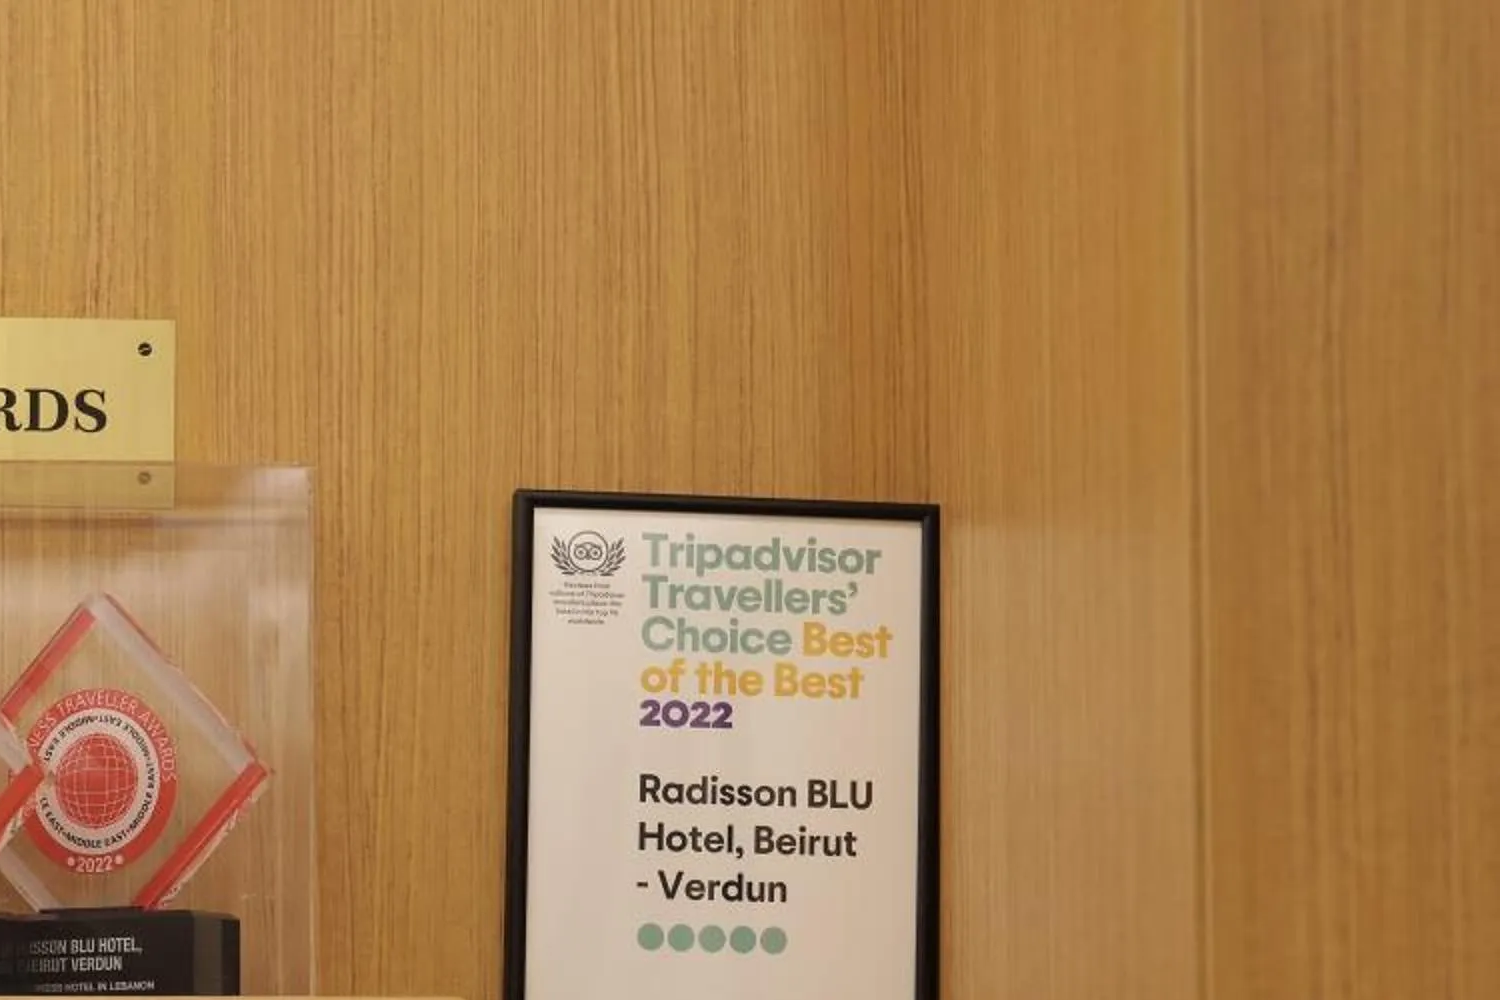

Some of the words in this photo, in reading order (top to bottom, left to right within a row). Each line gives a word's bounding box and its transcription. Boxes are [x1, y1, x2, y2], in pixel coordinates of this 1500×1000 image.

[642, 531, 882, 576] Tripadvisor
[642, 572, 858, 616] Travellers’
[641, 615, 793, 656] Choice
[803, 622, 893, 658] Best
[640, 658, 687, 695] of
[694, 661, 763, 696] the
[774, 663, 864, 698] Best
[640, 699, 734, 729] 2022
[58, 692, 139, 716] TRAVELLER
[139, 710, 177, 782] AWARDS
[639, 773, 797, 808] Radisson
[806, 780, 874, 810] BLU
[637, 821, 745, 860] Hotel,
[753, 825, 858, 857] Beirut
[76, 856, 113, 873] 2022
[658, 869, 787, 903] Verdun
[29, 940, 67, 955] ISSON
[71, 939, 95, 954] BLU
[99, 937, 143, 954] HOTEL,
[71, 955, 122, 972] VERDUN
